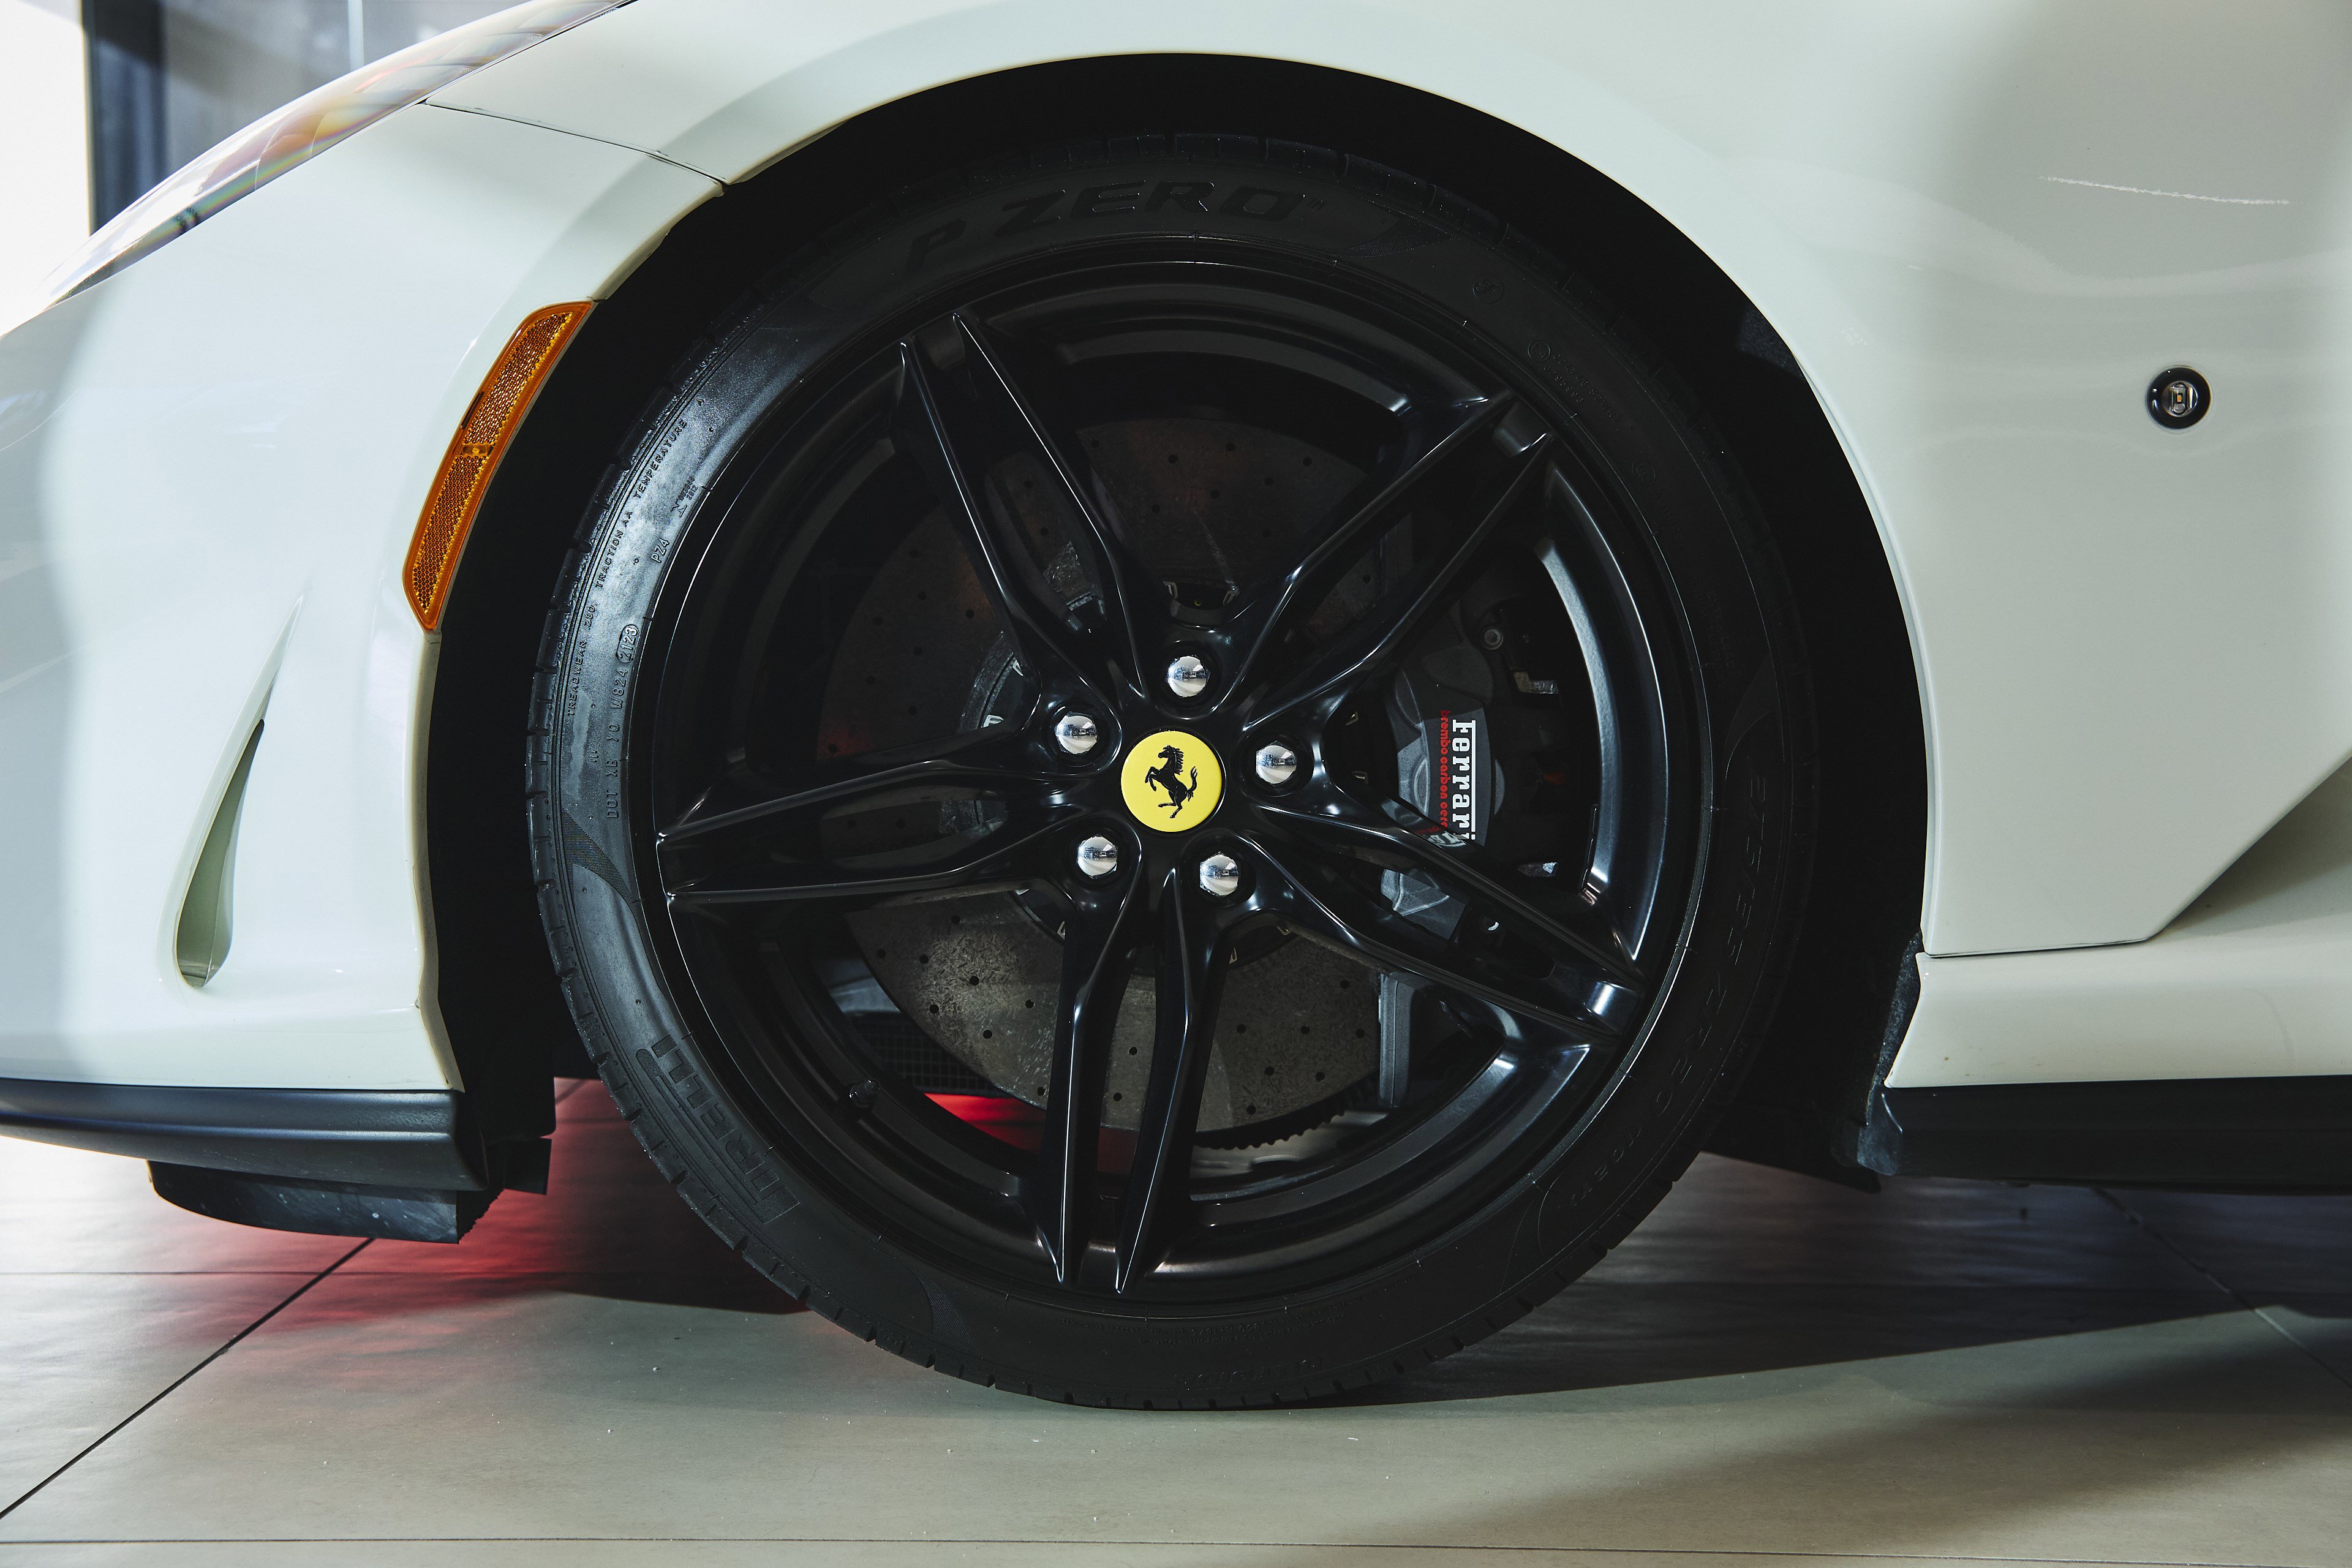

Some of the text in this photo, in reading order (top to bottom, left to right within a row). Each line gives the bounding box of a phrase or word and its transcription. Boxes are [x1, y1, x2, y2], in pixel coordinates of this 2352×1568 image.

[905, 217, 967, 275] P
[993, 181, 1305, 238] ZERO
[567, 639, 587, 717] TREADWEAR
[595, 529, 624, 589] TRACTION
[619, 509, 633, 527] AA
[632, 417, 688, 500] TEMPERATURE
[650, 537, 670, 564] PZ4
[605, 789, 619, 818] DOT
[617, 625, 638, 661] 2123
[1441, 710, 1450, 755] brembo
[1441, 756, 1450, 799] carbon
[1452, 720, 1476, 840] Ferrari
[636, 1035, 800, 1224] PIRELLI
